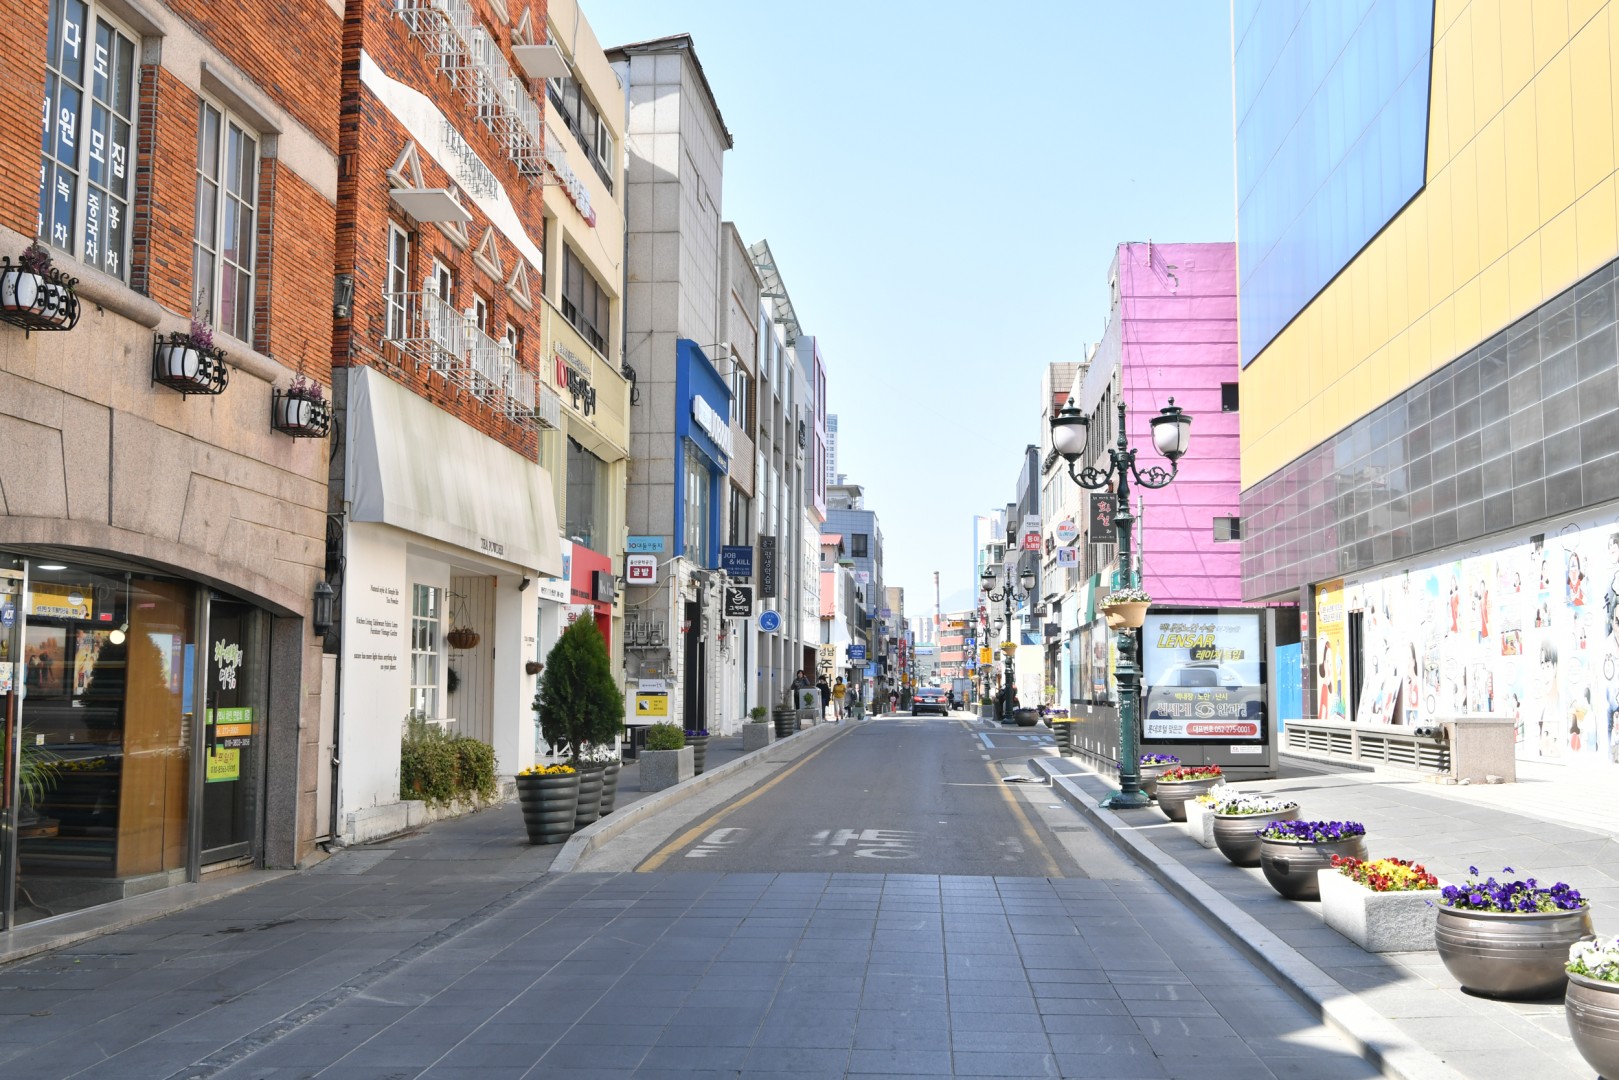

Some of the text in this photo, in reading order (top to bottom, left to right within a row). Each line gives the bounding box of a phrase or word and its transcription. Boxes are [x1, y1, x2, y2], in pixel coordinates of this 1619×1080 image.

[85, 193, 99, 264] 중국차
[3, 609, 14, 619] ADT
[1157, 634, 1215, 648] LENSAR
